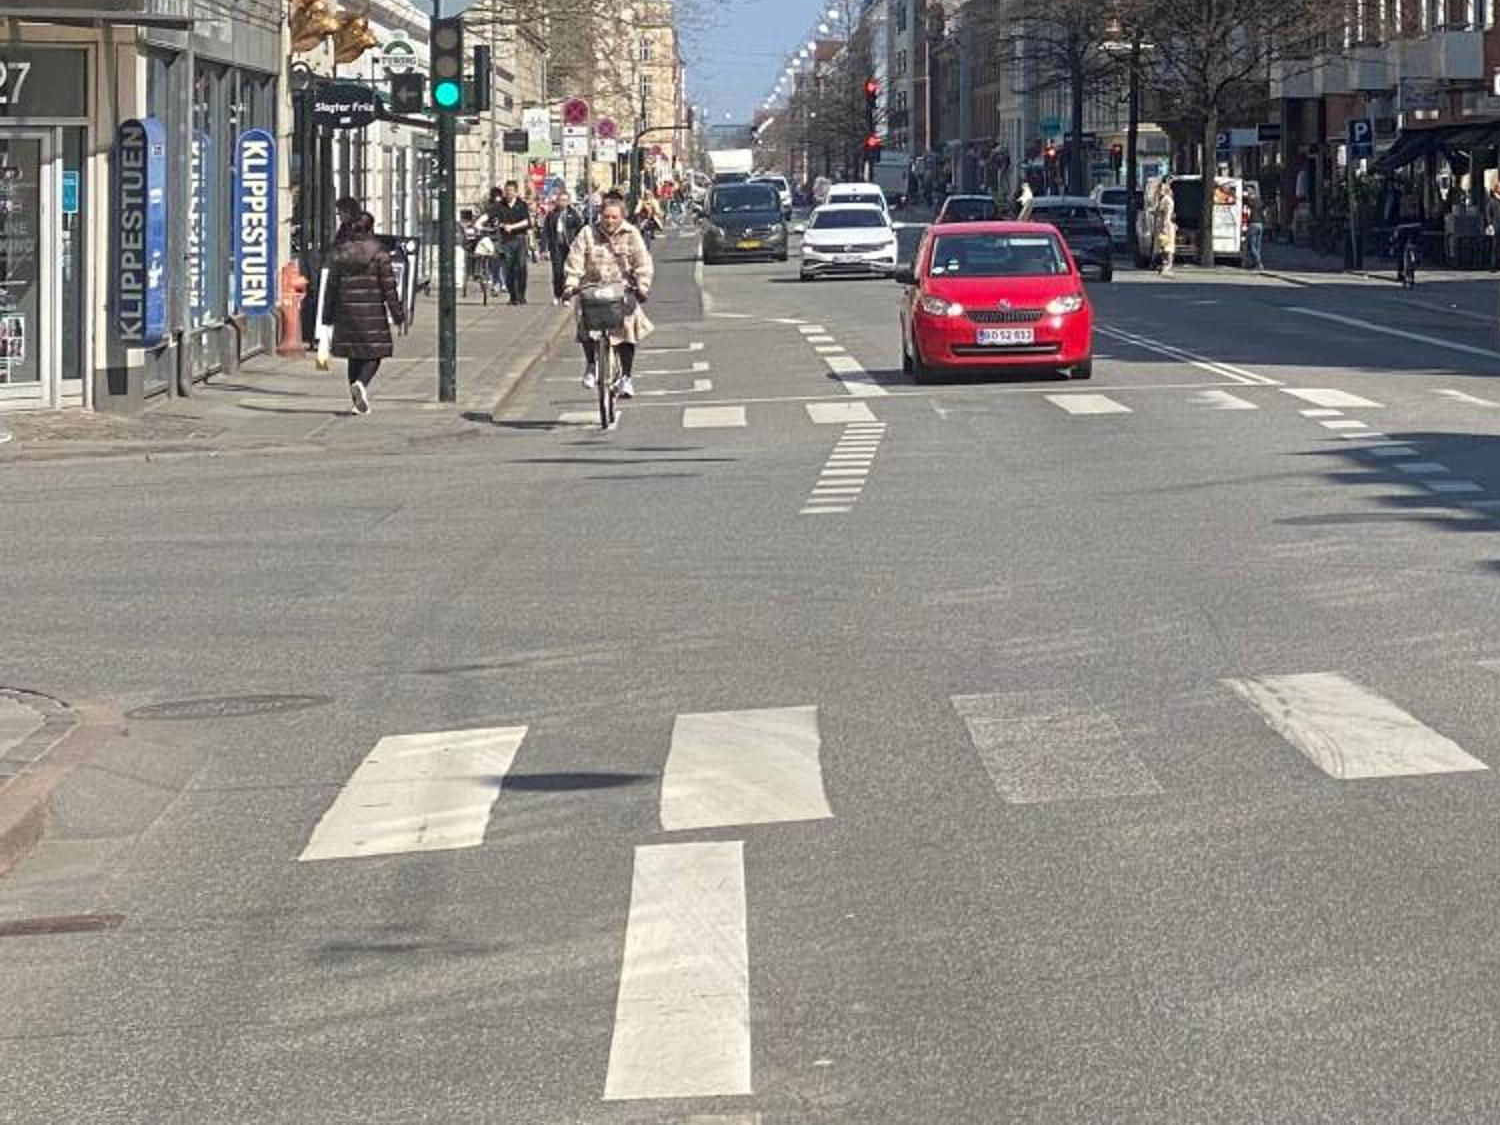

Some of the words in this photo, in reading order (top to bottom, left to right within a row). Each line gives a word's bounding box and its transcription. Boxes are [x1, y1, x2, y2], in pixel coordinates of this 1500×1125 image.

[314, 102, 350, 114] Slagter
[1355, 123, 1367, 141] P
[120, 125, 144, 341] KLIPPESTUEN
[241, 140, 268, 307] KLIPPESTUEN
